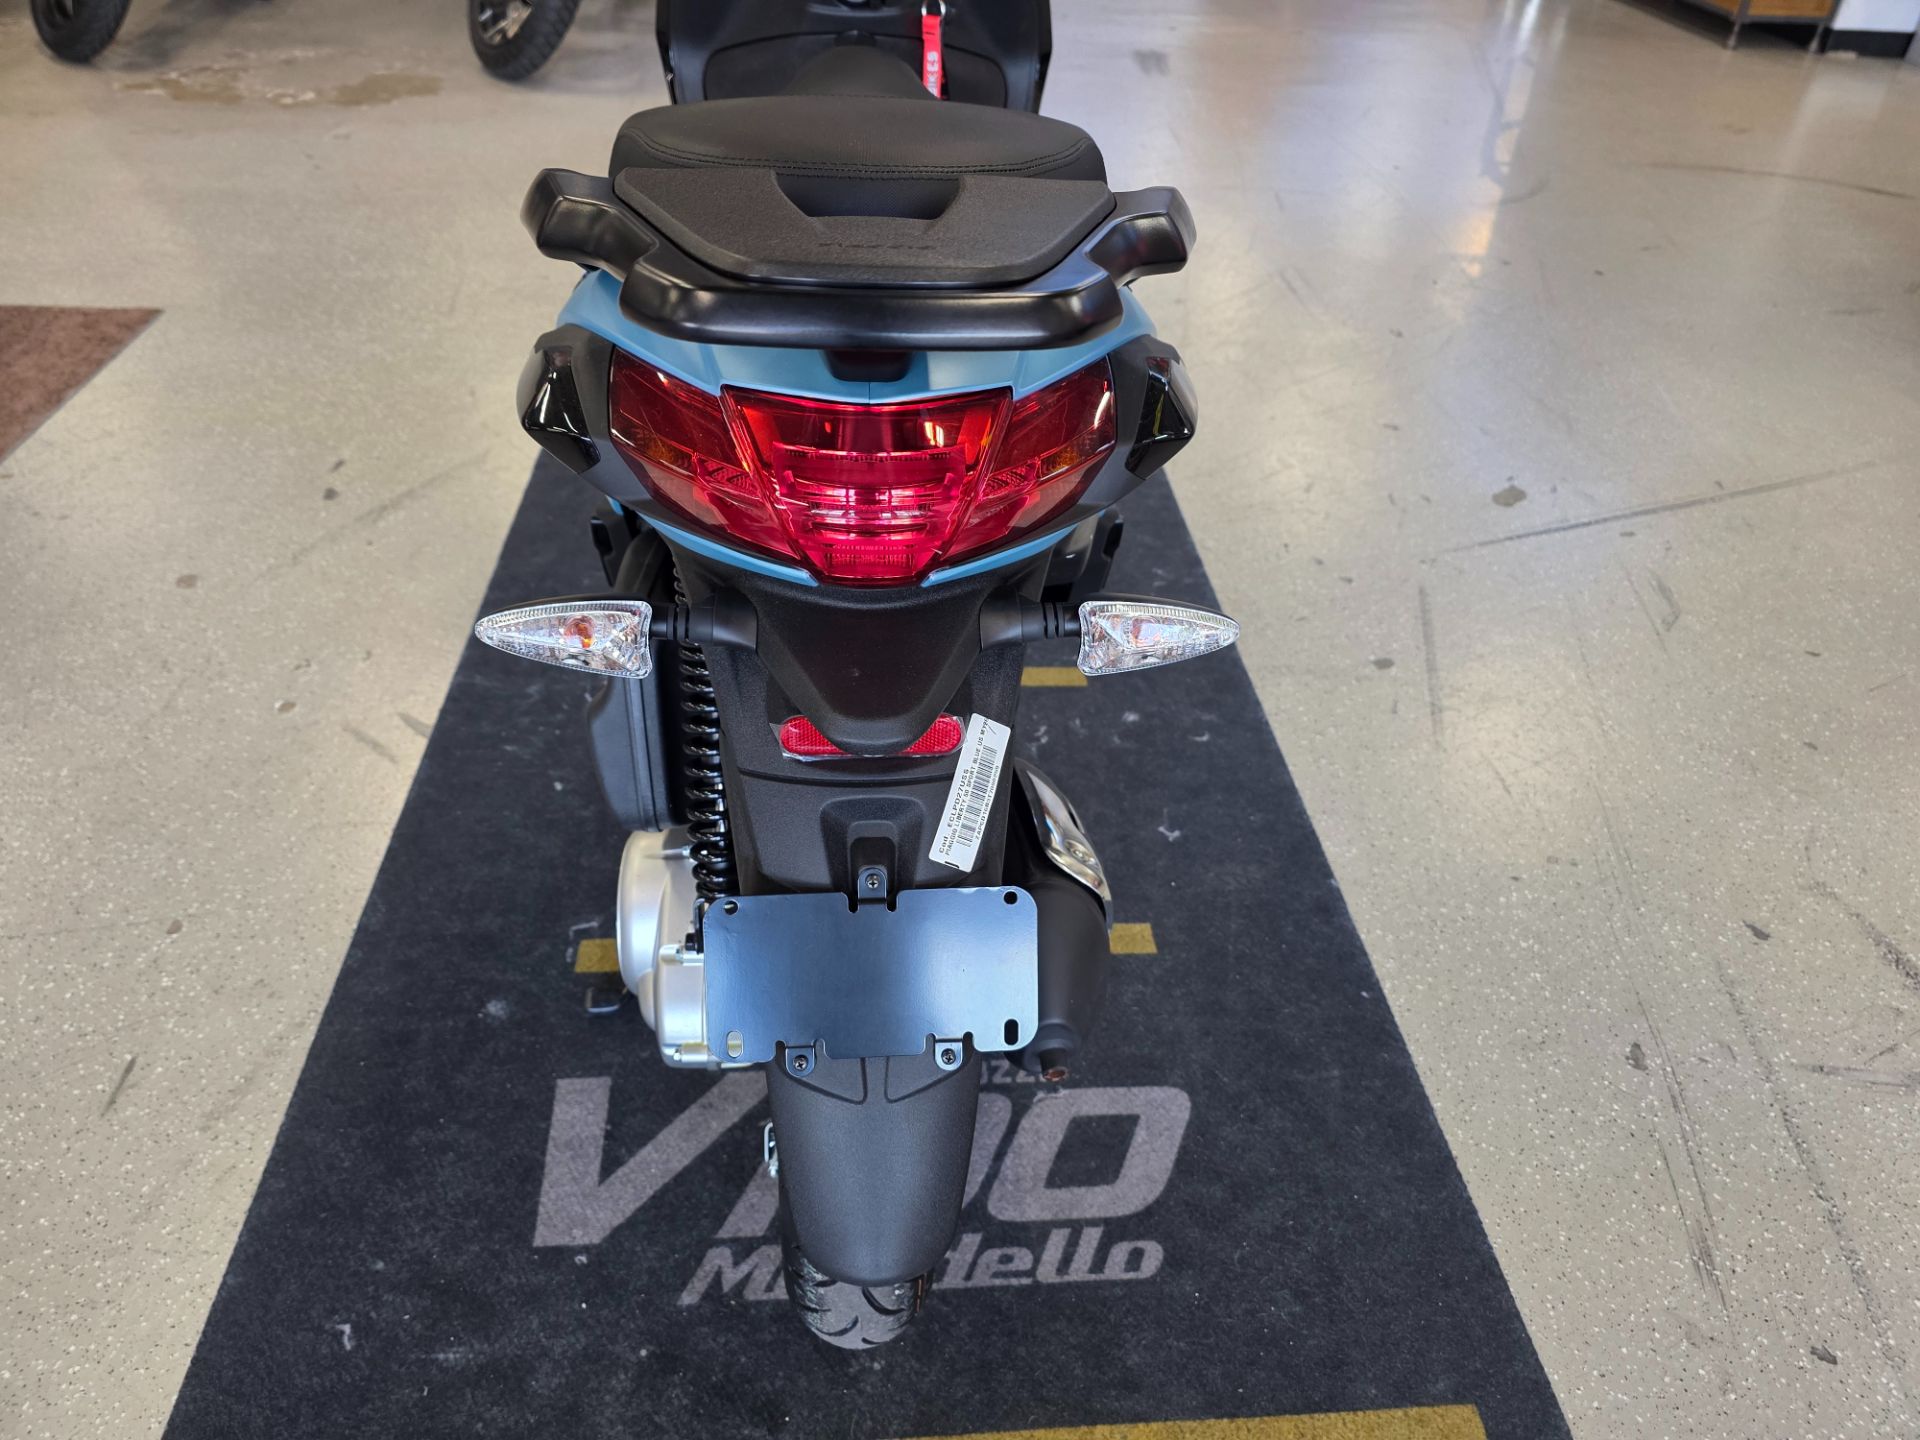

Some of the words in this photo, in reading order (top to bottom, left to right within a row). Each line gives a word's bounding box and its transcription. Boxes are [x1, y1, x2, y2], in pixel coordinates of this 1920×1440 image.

[945, 827, 958, 857] PIAGGIO
[954, 799, 967, 827] LIBERTY
[967, 766, 976, 787] SPORT
[972, 748, 981, 764] BLUE
[977, 736, 984, 746] US
